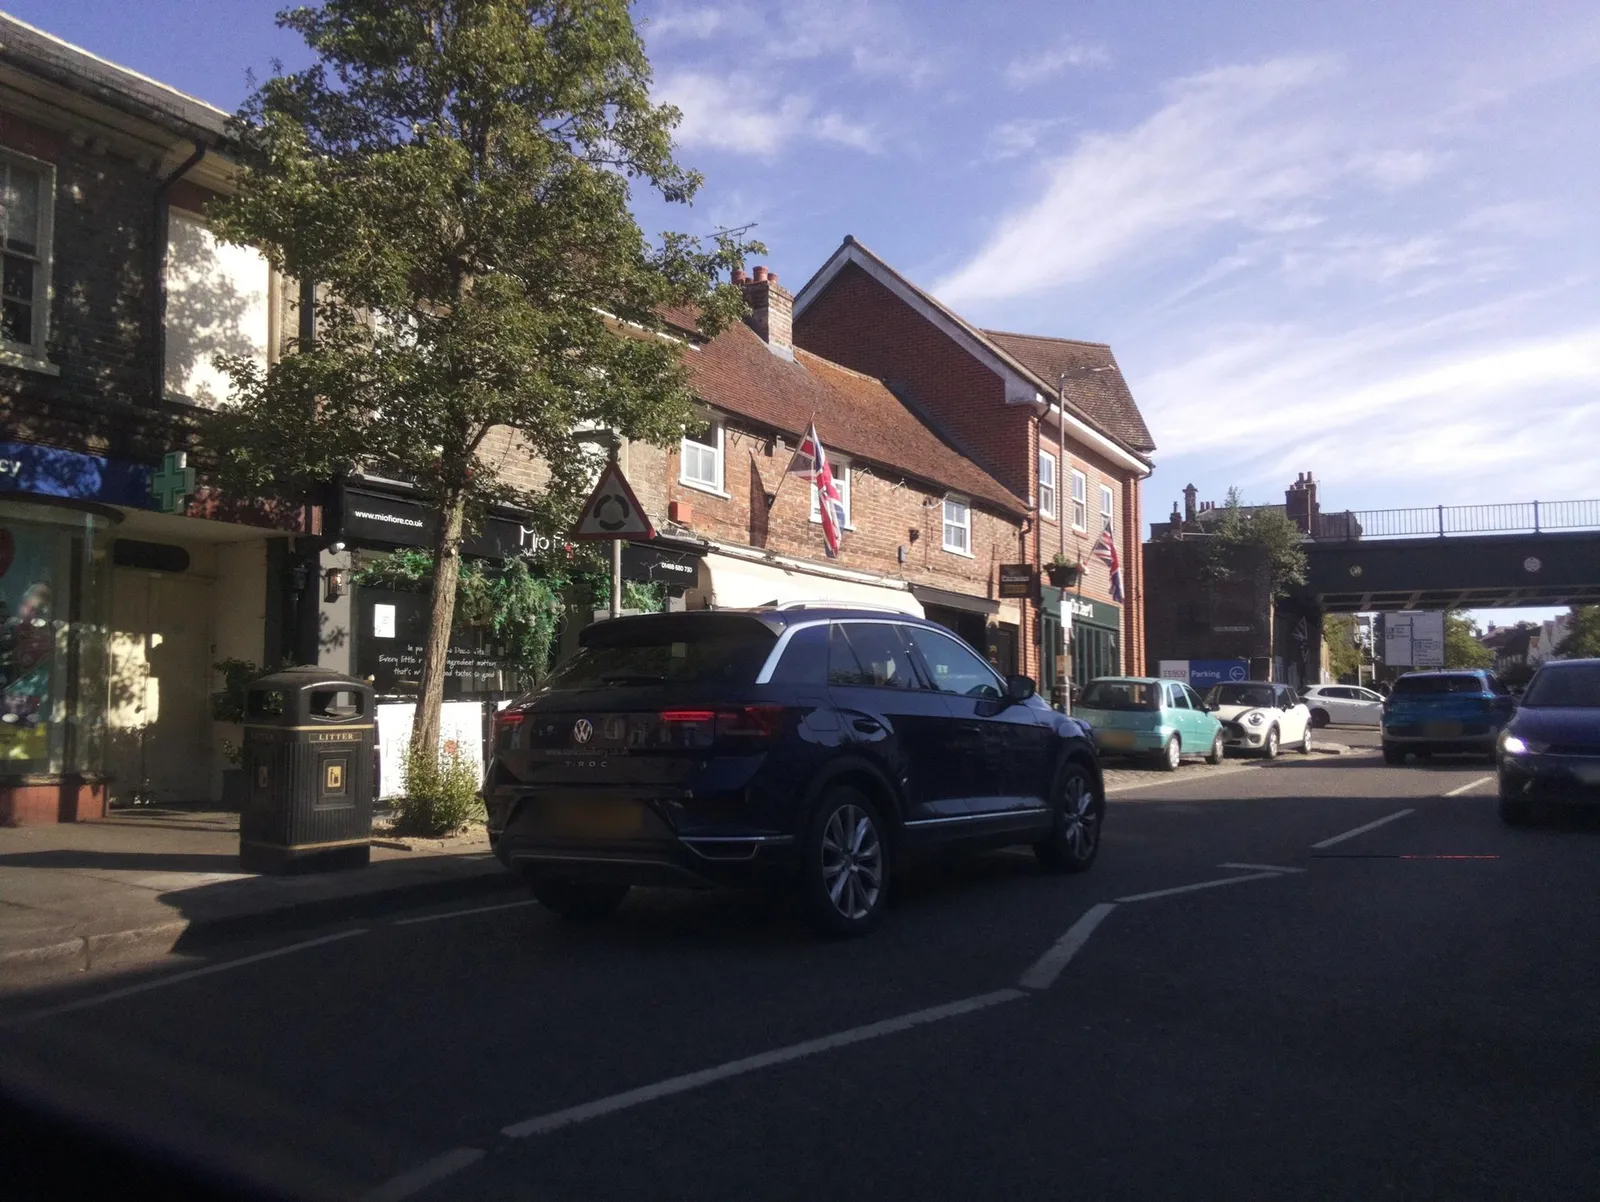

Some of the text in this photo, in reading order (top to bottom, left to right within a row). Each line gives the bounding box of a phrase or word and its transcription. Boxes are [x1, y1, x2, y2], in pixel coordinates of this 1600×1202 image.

[355, 510, 423, 527] www.miofiore.co.uk
[520, 525, 550, 553] Mio
[379, 654, 399, 667] Every
[400, 655, 416, 664] little
[393, 667, 412, 676] that's
[455, 669, 472, 677] tastes
[482, 670, 495, 682] good
[1191, 670, 1221, 679] Parking
[318, 733, 353, 741] LITTER
